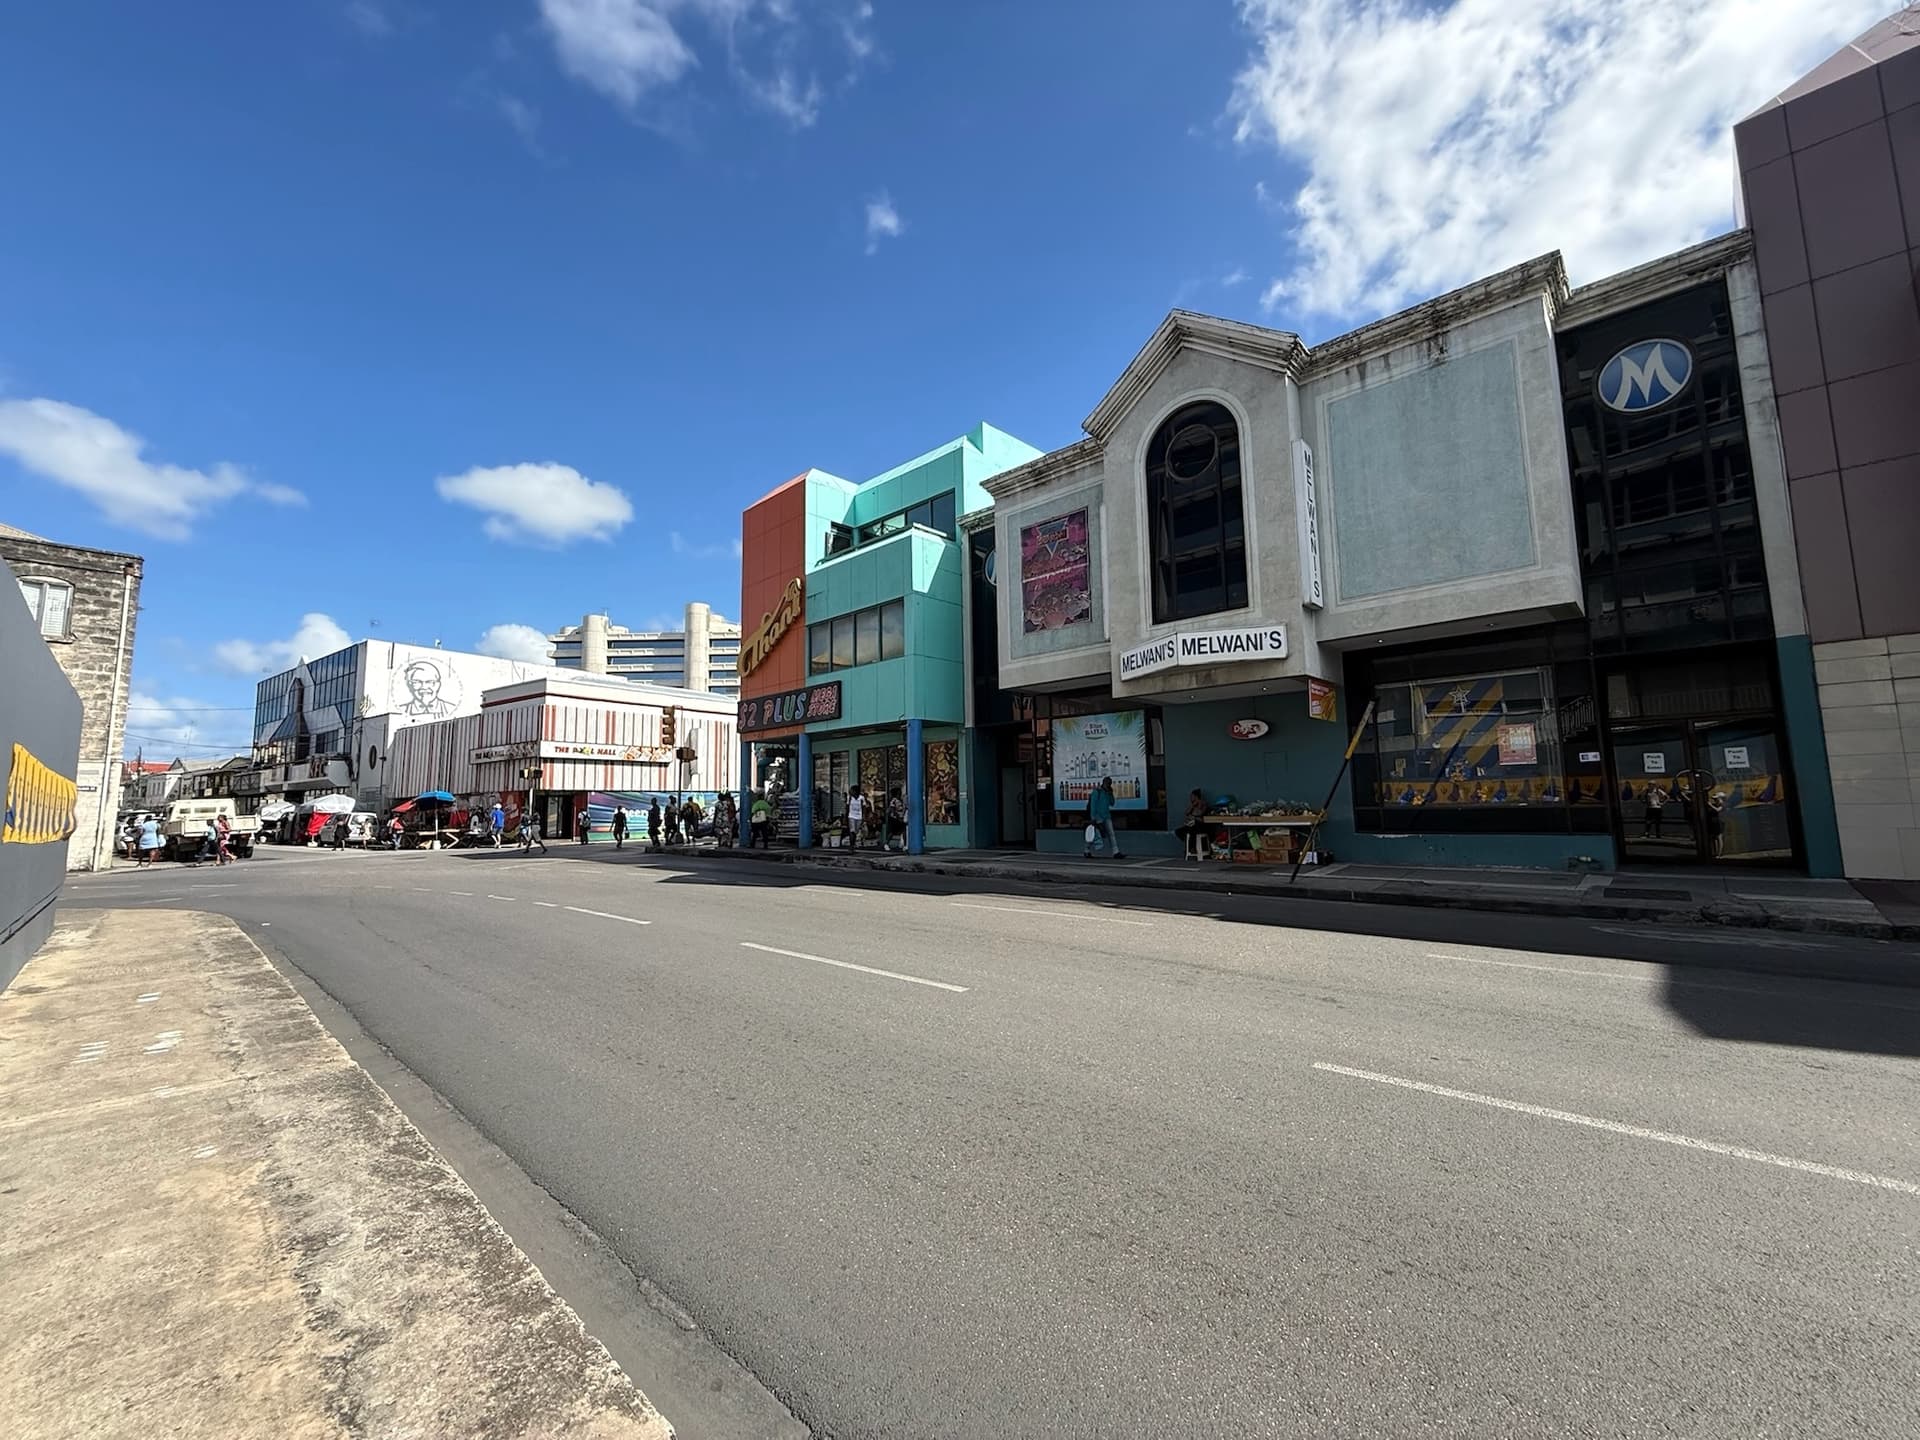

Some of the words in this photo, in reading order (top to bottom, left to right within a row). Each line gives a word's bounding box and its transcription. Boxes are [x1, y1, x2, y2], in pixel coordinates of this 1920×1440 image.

[1304, 449, 1320, 598] MELWANI'S
[1122, 640, 1175, 673] MELWANI'S
[1182, 630, 1282, 656] MELWANI'S
[763, 692, 807, 725] PLUS
